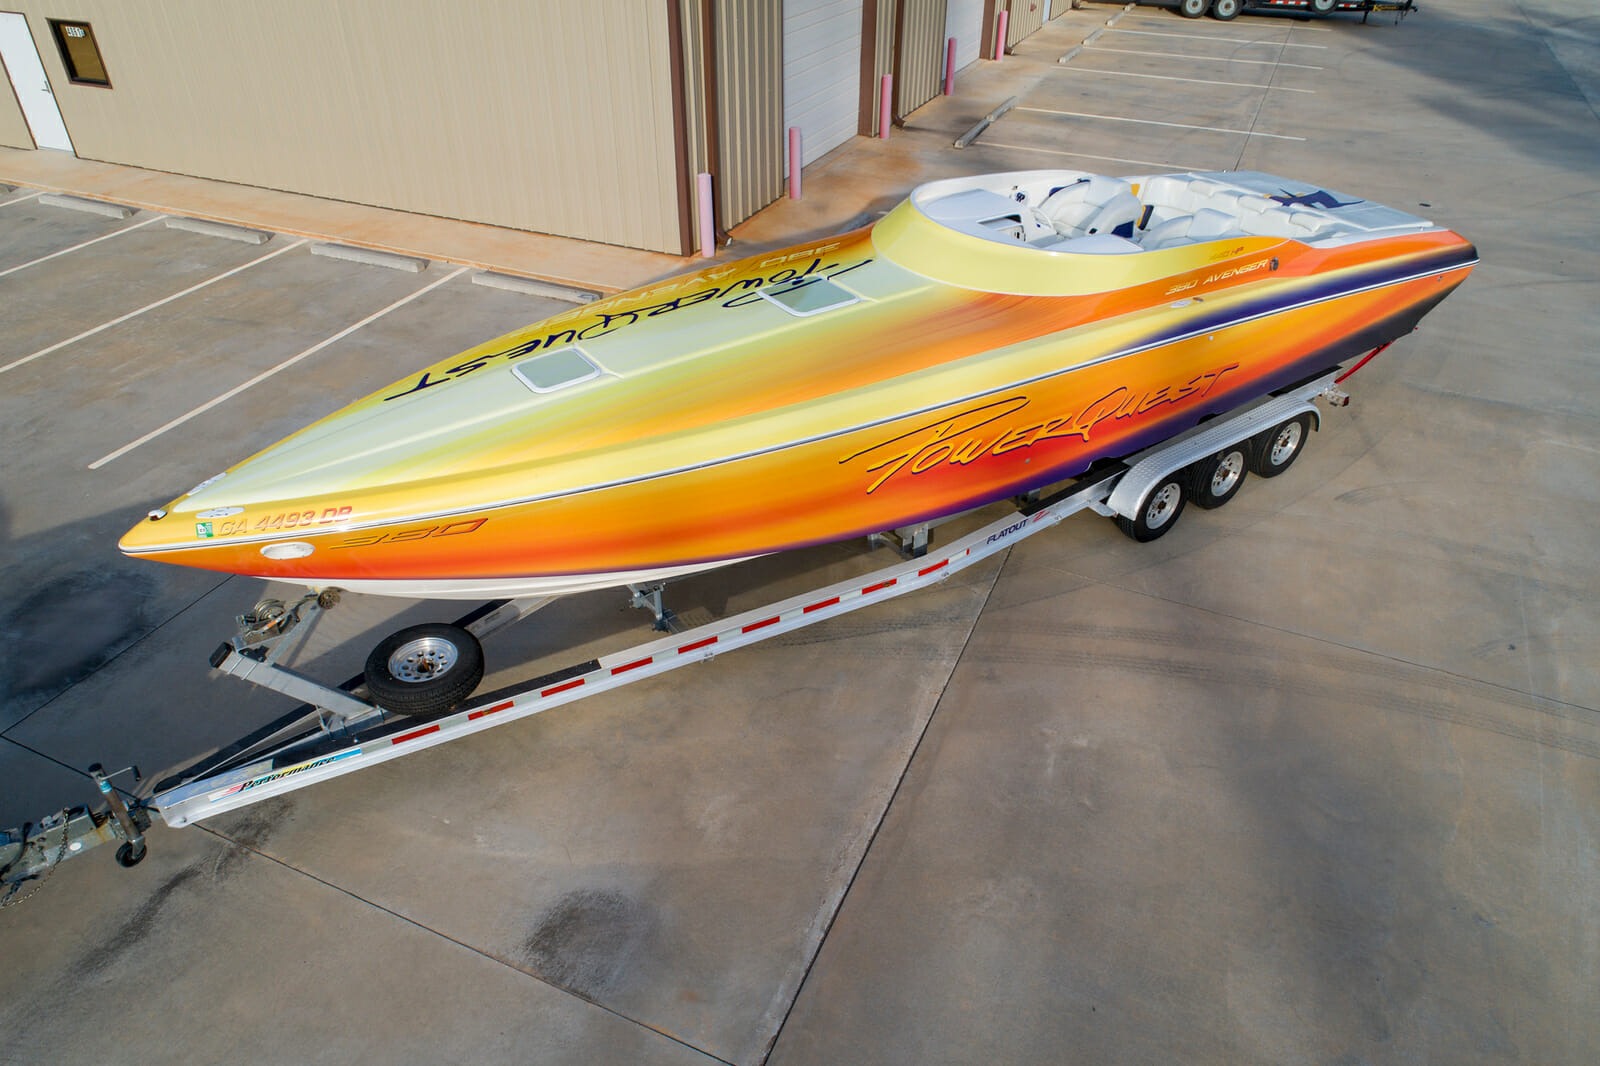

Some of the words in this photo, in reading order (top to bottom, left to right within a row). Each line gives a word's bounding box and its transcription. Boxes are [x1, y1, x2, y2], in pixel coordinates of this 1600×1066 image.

[1202, 258, 1269, 285] AVENGER
[219, 519, 249, 537] GA
[253, 510, 316, 532] 4493
[319, 505, 353, 524] DB
[986, 518, 1029, 545] FLATOUT
[238, 756, 336, 793] Performance
